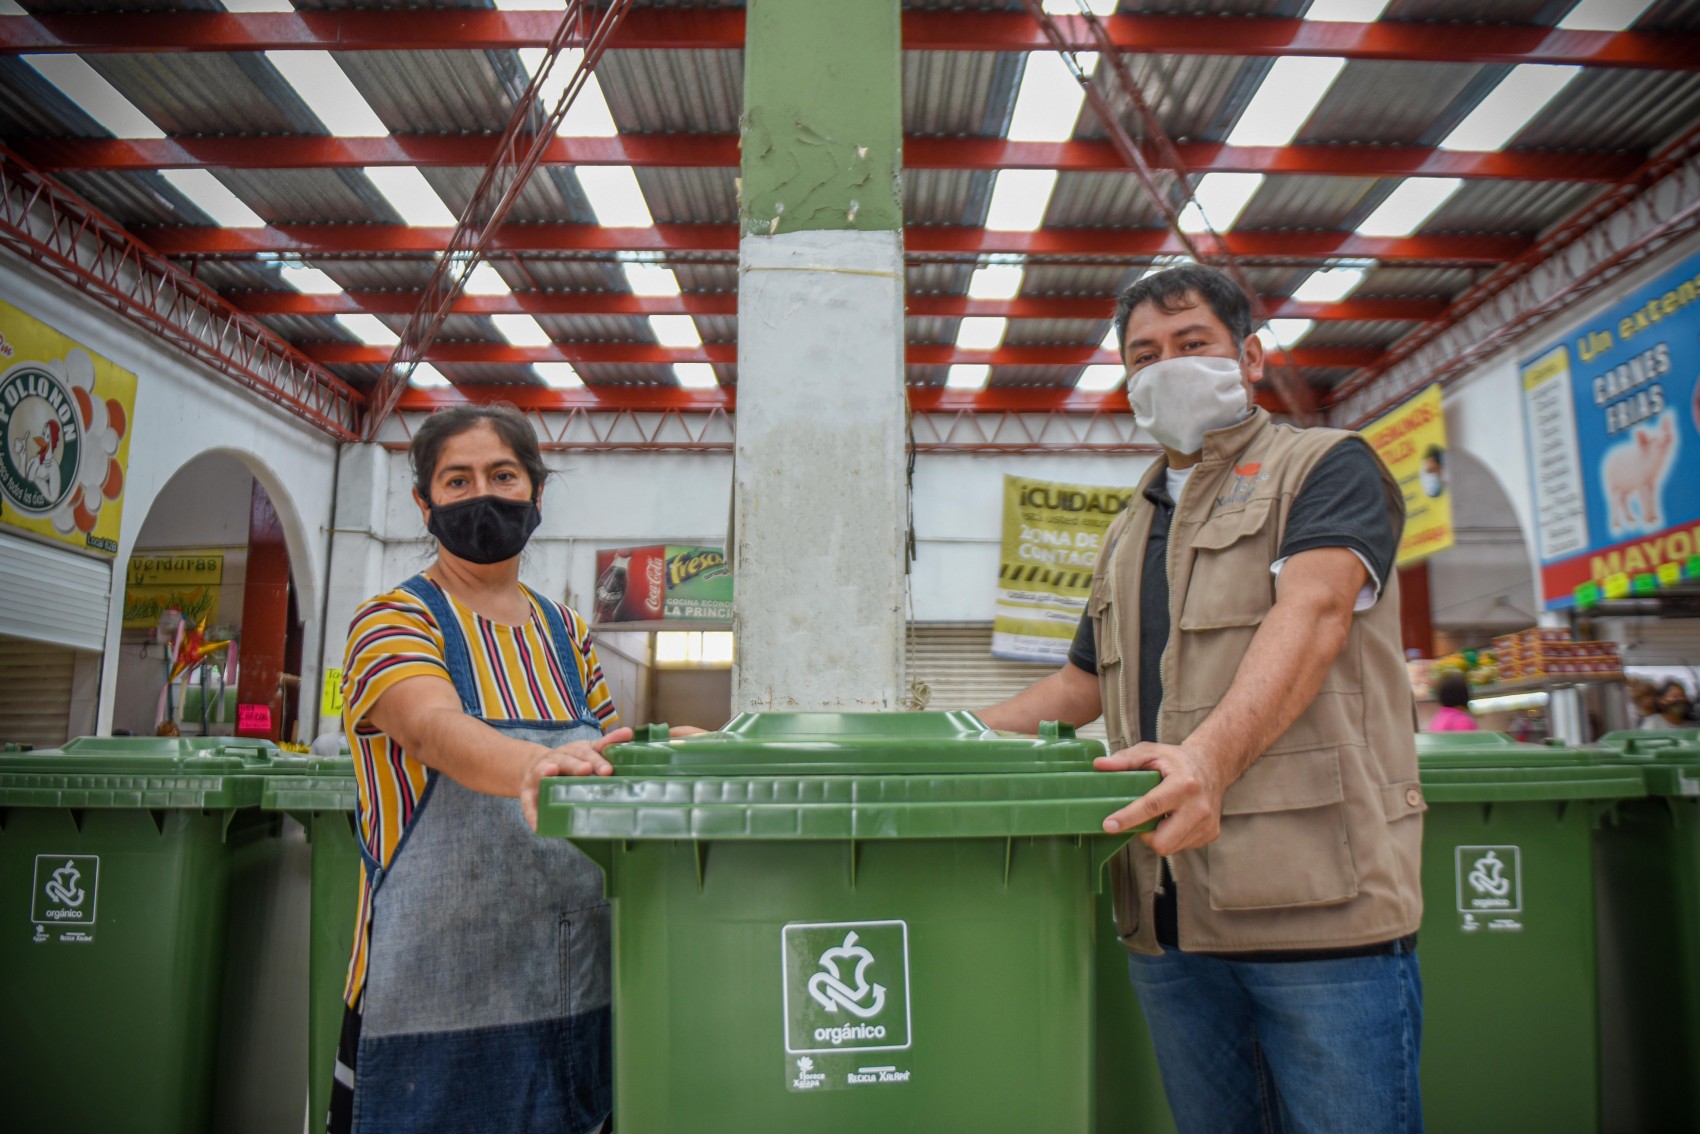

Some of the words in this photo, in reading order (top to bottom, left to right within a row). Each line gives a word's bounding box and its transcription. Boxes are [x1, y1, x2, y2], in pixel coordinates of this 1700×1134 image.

[1577, 331, 1612, 361] Un
[1619, 274, 1700, 339] exten
[1593, 342, 1670, 404] CARNES
[1020, 525, 1072, 547] ZONA
[1076, 532, 1099, 549] DE
[133, 556, 217, 572] verduras
[1019, 543, 1097, 567] CONTAG
[664, 605, 682, 617] LA
[684, 606, 733, 619] PRINCI
[666, 598, 700, 607] COCINA
[701, 600, 732, 608] ECONO
[46, 908, 83, 919] orgánico
[814, 1023, 886, 1044] orgánico
